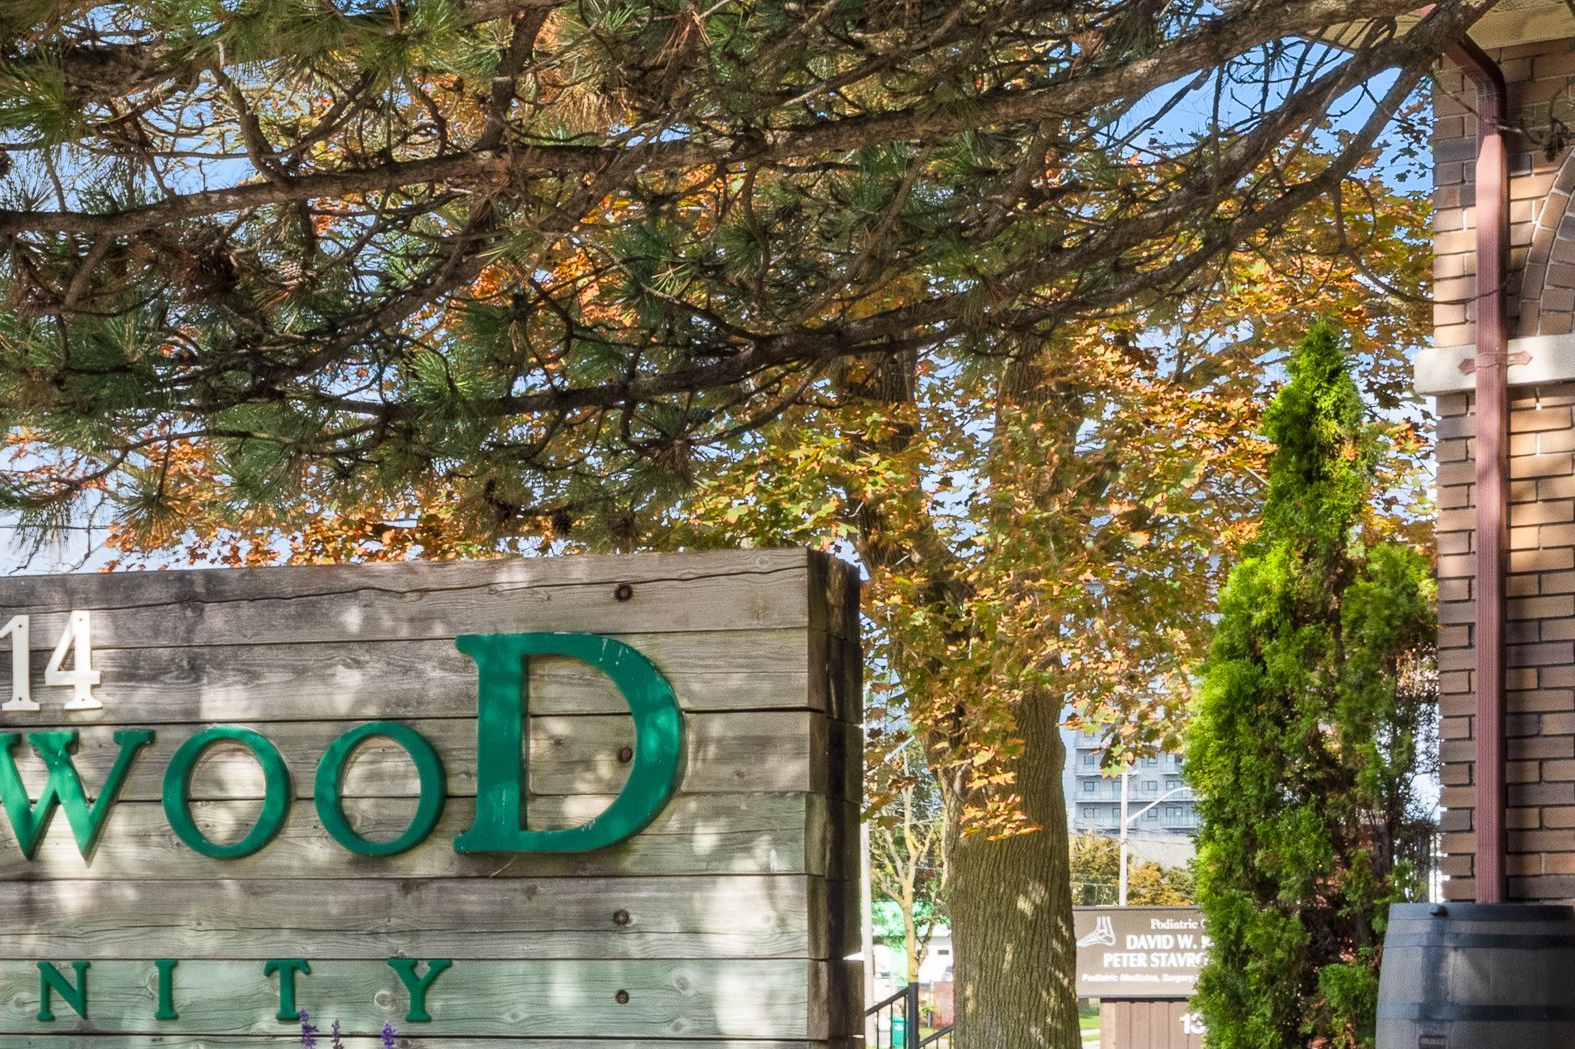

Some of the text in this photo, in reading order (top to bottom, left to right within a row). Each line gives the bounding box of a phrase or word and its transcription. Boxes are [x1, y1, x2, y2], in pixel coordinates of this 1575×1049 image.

[1150, 918, 1198, 930] Podiatric
[1126, 934, 1175, 950] DAVID
[1177, 934, 1198, 950] W.
[1103, 952, 1147, 968] PETER
